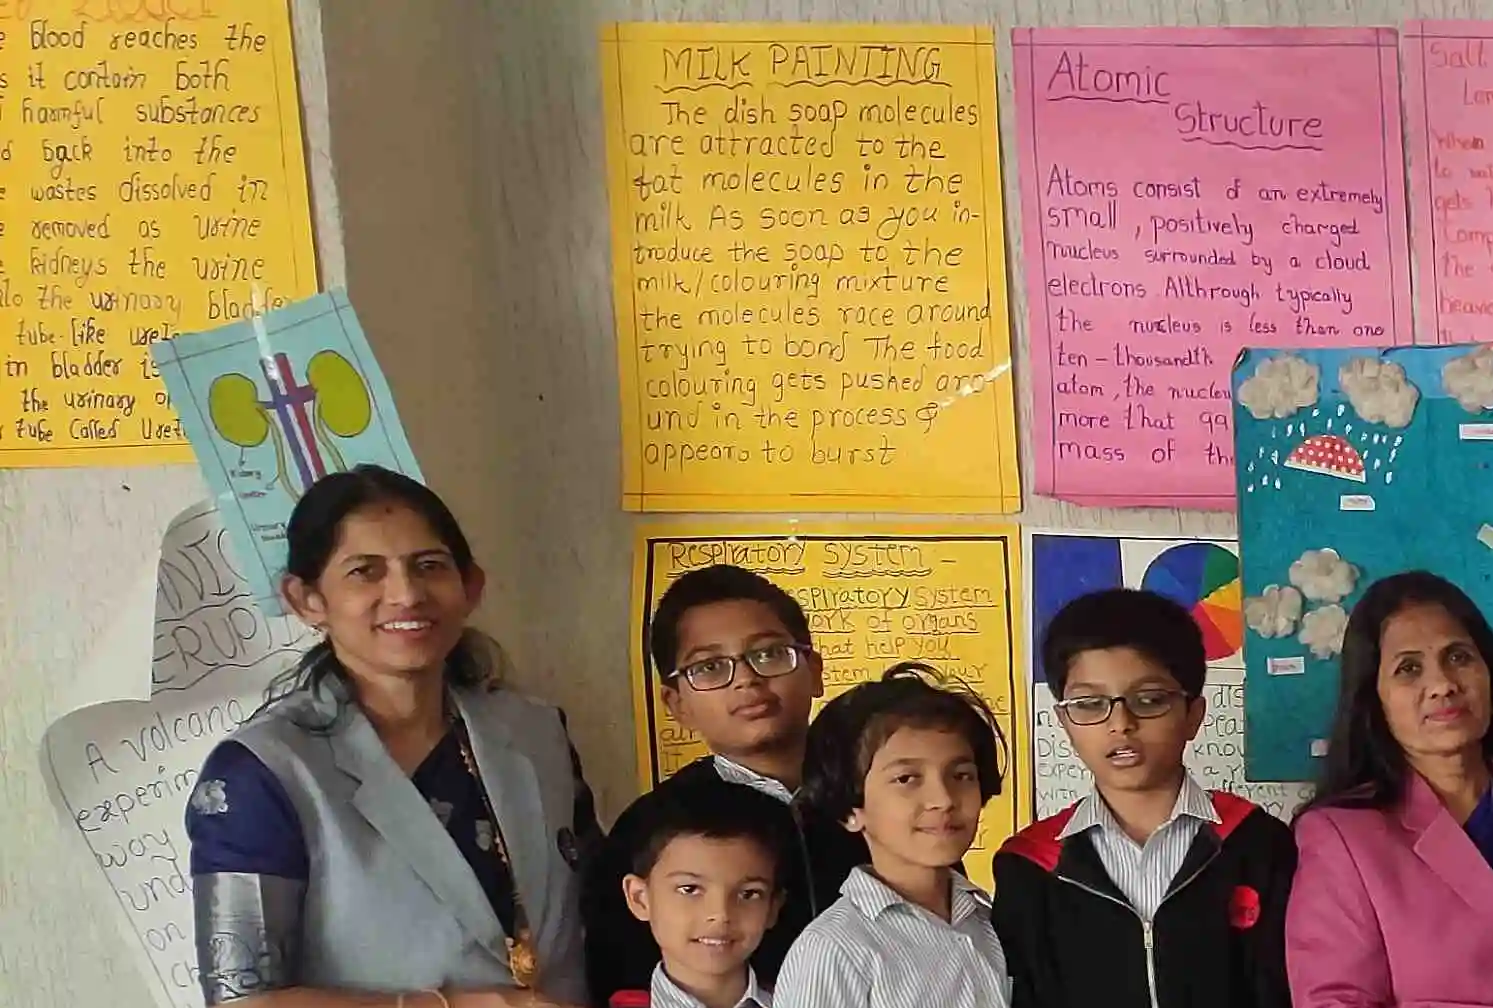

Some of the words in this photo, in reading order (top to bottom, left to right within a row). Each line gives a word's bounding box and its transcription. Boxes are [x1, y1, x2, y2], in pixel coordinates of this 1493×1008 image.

[31, 18, 85, 48] blood
[110, 31, 199, 50] reaches
[228, 18, 266, 53] the
[663, 47, 749, 80] MILK
[771, 44, 942, 80] PAINTING
[1048, 50, 1170, 97] Atomic
[22, 98, 102, 127] harmful
[137, 91, 261, 123] substances
[661, 101, 707, 124] The
[725, 99, 776, 124] dish
[790, 101, 846, 130] soap
[860, 104, 978, 124] molecules
[1175, 103, 1323, 139] Structure
[630, 135, 685, 156] are
[701, 132, 835, 157] attracted
[857, 137, 884, 155] to
[897, 137, 945, 159] the
[1047, 164, 1117, 199] Atoms
[1133, 177, 1201, 200] consist
[31, 218, 110, 238] removed
[139, 220, 160, 237] as
[1048, 205, 1117, 230] small
[1152, 215, 1254, 242] positively
[1282, 218, 1360, 238] charged
[85, 741, 116, 775] A
[123, 699, 242, 766] volcano
